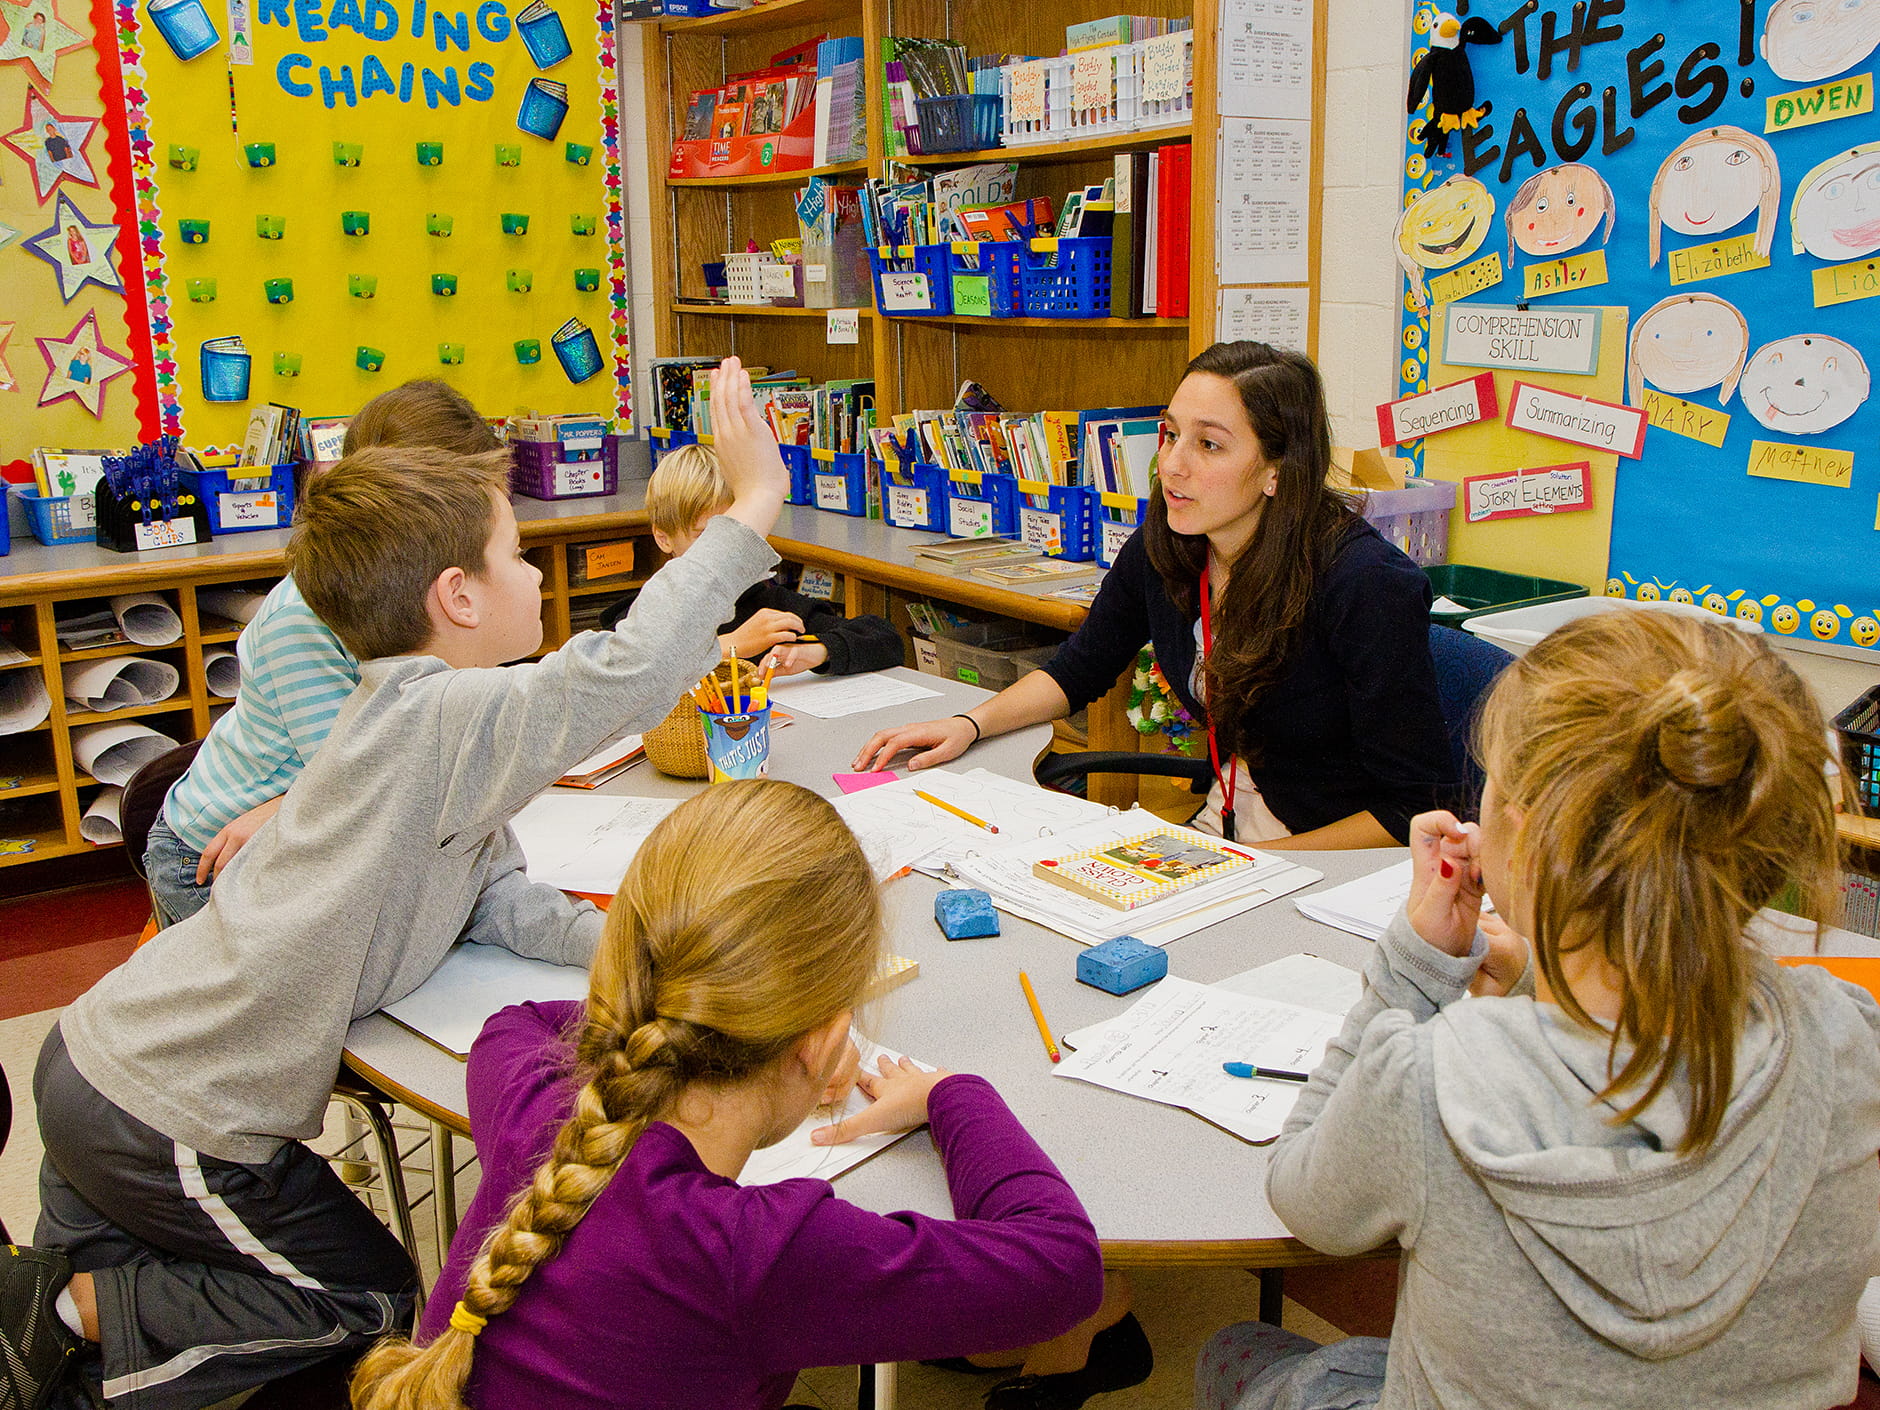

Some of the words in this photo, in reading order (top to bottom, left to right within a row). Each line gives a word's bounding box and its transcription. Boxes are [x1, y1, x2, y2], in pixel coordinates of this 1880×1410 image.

[669, 4, 688, 12] EPSON
[258, 0, 511, 51] READING
[1148, 41, 1176, 60] Buddy
[1499, 0, 1625, 80] THE
[1078, 56, 1102, 76] Buddy
[1154, 58, 1180, 76] Guided
[276, 53, 495, 109] CHAINS
[1774, 84, 1863, 126] OWEN
[1534, 263, 1587, 290] Ashley
[1675, 250, 1752, 281] Elizabeth
[893, 278, 914, 286] Science
[956, 281, 988, 306] SEASONS
[1455, 315, 1582, 339] COMPREHENSION
[1489, 338, 1539, 362] SKILL
[1399, 400, 1475, 434] Sequencing
[1526, 396, 1616, 445] Summarizing
[1644, 393, 1713, 437] MARY
[564, 468, 589, 479] Chapter
[1479, 482, 1518, 508] STORY
[1522, 478, 1583, 503] ELEMENTS
[957, 502, 976, 514] Social
[144, 521, 174, 536] BOOK
[959, 517, 981, 528] Studies
[153, 532, 184, 546] CLIPS
[718, 745, 746, 770] THAT'S
[745, 725, 767, 760] JUST
[1081, 867, 1127, 887] CLASS
[1086, 861, 1145, 884] CLOWN
